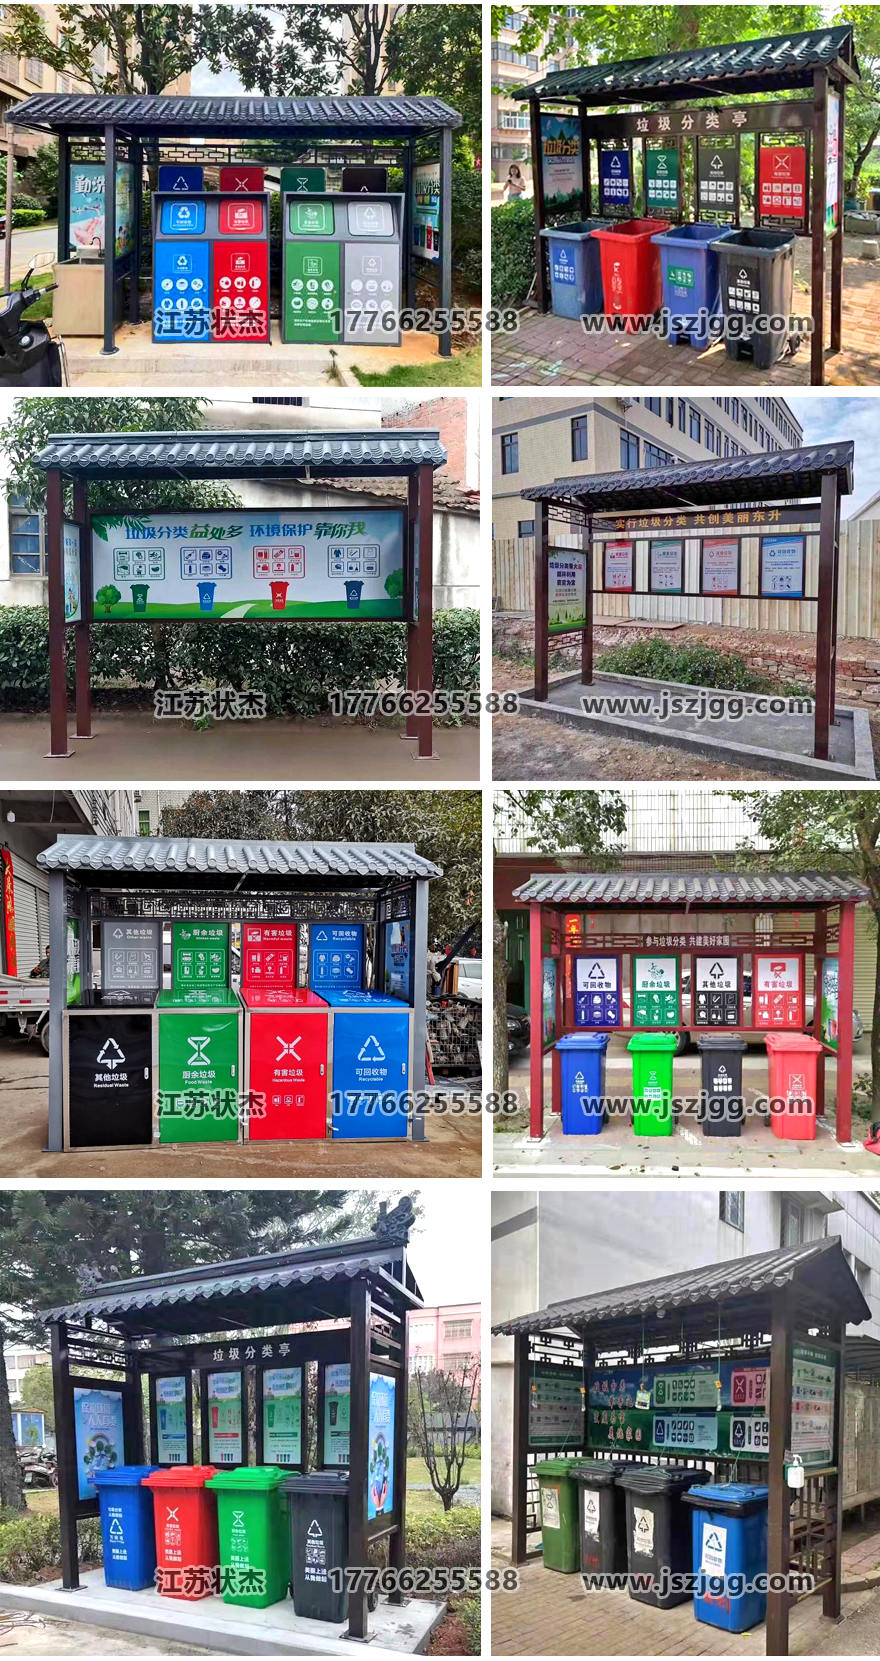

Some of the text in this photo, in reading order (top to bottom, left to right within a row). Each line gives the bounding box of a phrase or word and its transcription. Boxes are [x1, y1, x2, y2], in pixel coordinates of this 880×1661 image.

[636, 110, 748, 133] 垃圾分类亭
[615, 508, 782, 530] 实行垃圾分类 共创美丽东升
[124, 520, 368, 541] 垃圾分类益处多 环境保护靠你我
[263, 929, 293, 937] 有害垃圾
[645, 935, 730, 947] 参与垃圾分类 共建美好家园
[582, 981, 612, 989] 可回收物
[641, 981, 671, 989] 厨余垃圾
[701, 980, 732, 989] 其他垃圾
[763, 980, 793, 989] 有害垃圾
[182, 1070, 216, 1079] 厨余垃圾
[273, 1068, 304, 1077] 有害垃圾
[355, 1067, 388, 1077] 可回收物
[94, 1072, 128, 1082] 其他垃圾
[212, 1342, 291, 1362] 垃圾分类亭
